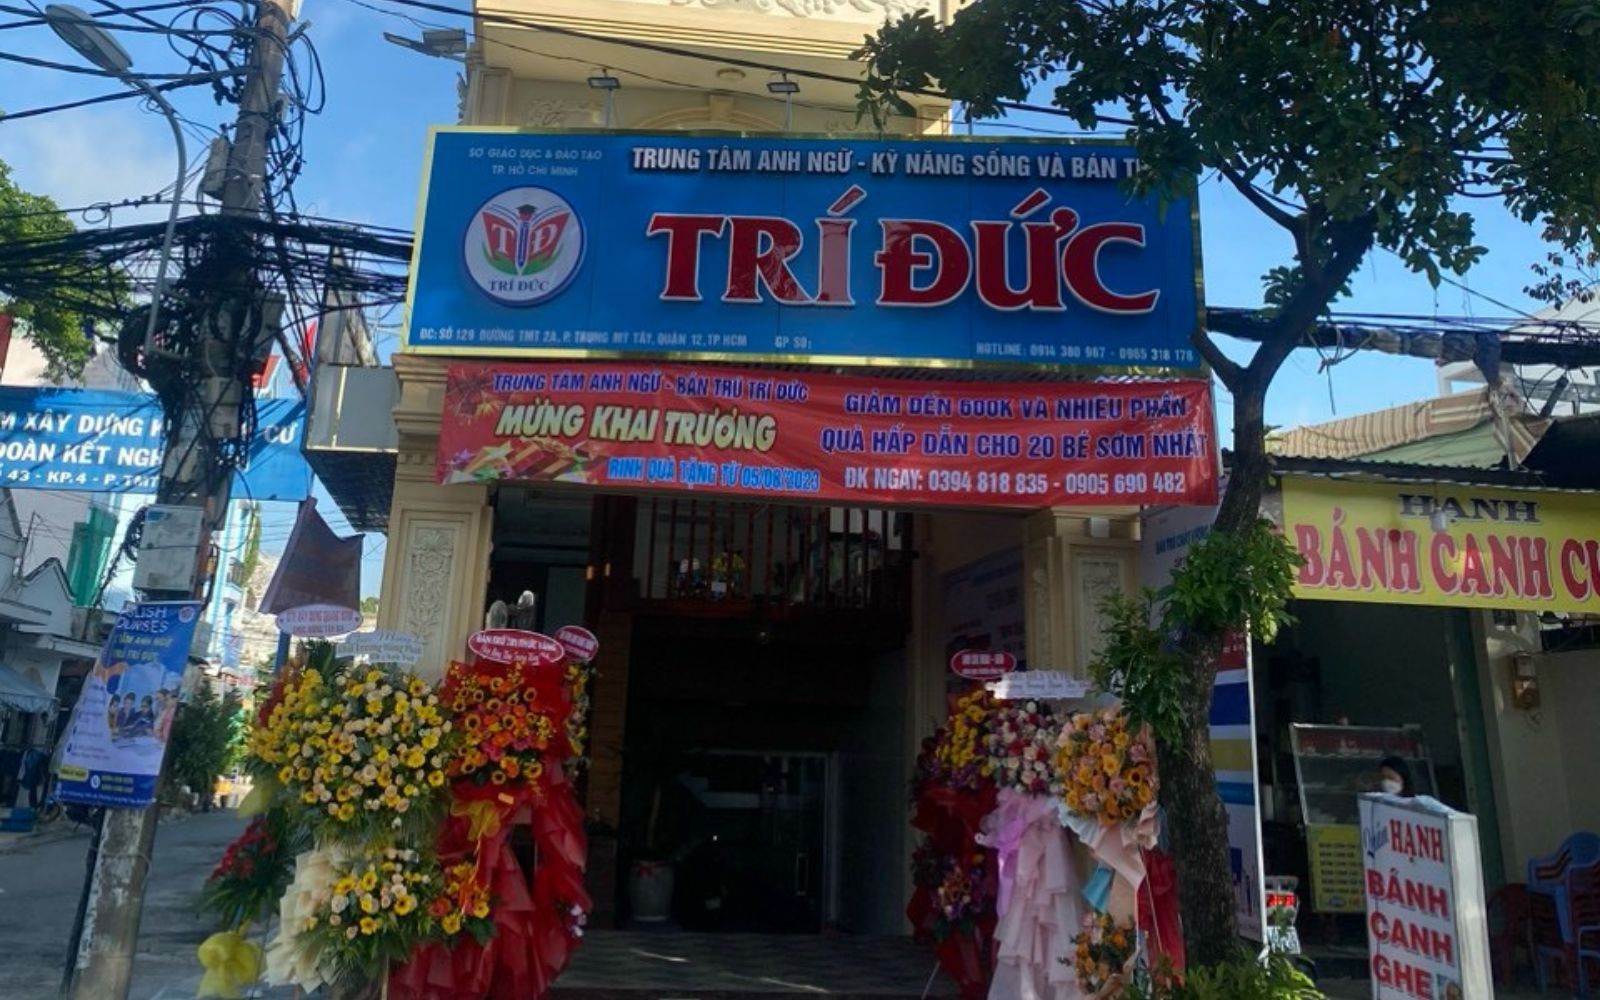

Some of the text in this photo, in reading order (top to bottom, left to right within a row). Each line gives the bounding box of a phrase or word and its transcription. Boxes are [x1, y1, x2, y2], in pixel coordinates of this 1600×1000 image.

[545, 150, 553, 159] &
[632, 148, 700, 171] TRUNG
[708, 147, 751, 172] TÂM
[757, 150, 800, 173] ANH
[807, 149, 853, 174] NGỮ
[871, 150, 898, 175] KỸ
[905, 150, 965, 176] NĂNG
[972, 149, 1030, 177] SỐNG
[1038, 154, 1065, 178] VÀ
[1071, 152, 1117, 178] BÁN
[646, 184, 1161, 315] TRÍ ĐỨC
[488, 278, 515, 292] TRÍ
[493, 373, 546, 391] TRUNG
[552, 370, 586, 391] TÂM
[589, 373, 623, 392] ANH
[627, 369, 662, 394] NGỮ
[24, 408, 72, 433] XÂY
[1021, 396, 1048, 419] VÀ
[495, 398, 777, 451] MỪNG KHAI TRƯƠNG
[872, 423, 916, 454] HẤP
[922, 424, 969, 456] DẪN
[976, 434, 1021, 458] CHO
[1027, 435, 1056, 459] 20
[1062, 429, 1090, 460] BÉ
[7, 469, 30, 482] 43
[608, 457, 644, 480] RINH
[680, 457, 717, 488] TẶNG
[720, 461, 741, 486] TỪ
[844, 467, 868, 490] ĐK
[873, 467, 923, 490] NGAY:
[928, 469, 972, 492] 0394
[977, 471, 1010, 493] 818
[1015, 472, 1048, 494] 835
[1066, 472, 1107, 494] 0905
[1114, 472, 1147, 494] 690
[1152, 471, 1186, 493] 482
[1293, 506, 1425, 594] BÁNH
[1430, 532, 1557, 601] CANH
[1389, 818, 1445, 864] HẠNH
[1366, 867, 1450, 918] BÁNH
[1370, 910, 1454, 966] CANH
